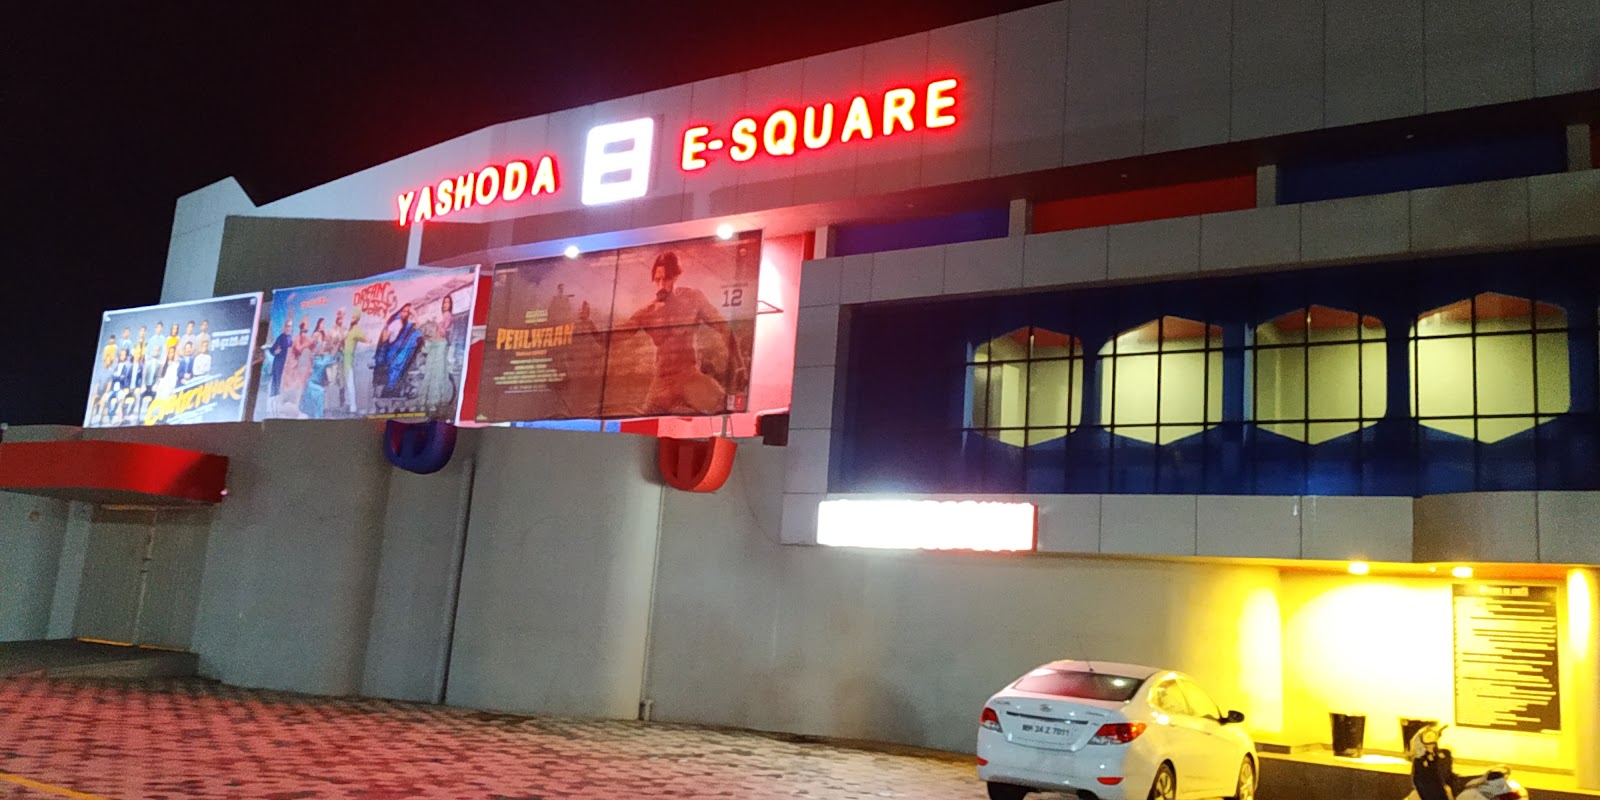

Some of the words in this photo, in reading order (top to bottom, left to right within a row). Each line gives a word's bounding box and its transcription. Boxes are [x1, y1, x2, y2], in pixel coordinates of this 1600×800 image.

[396, 155, 557, 226] YASHODA
[681, 78, 959, 171] E-SQUARE
[722, 288, 743, 307] 12
[496, 323, 575, 350] PEHLWAAN
